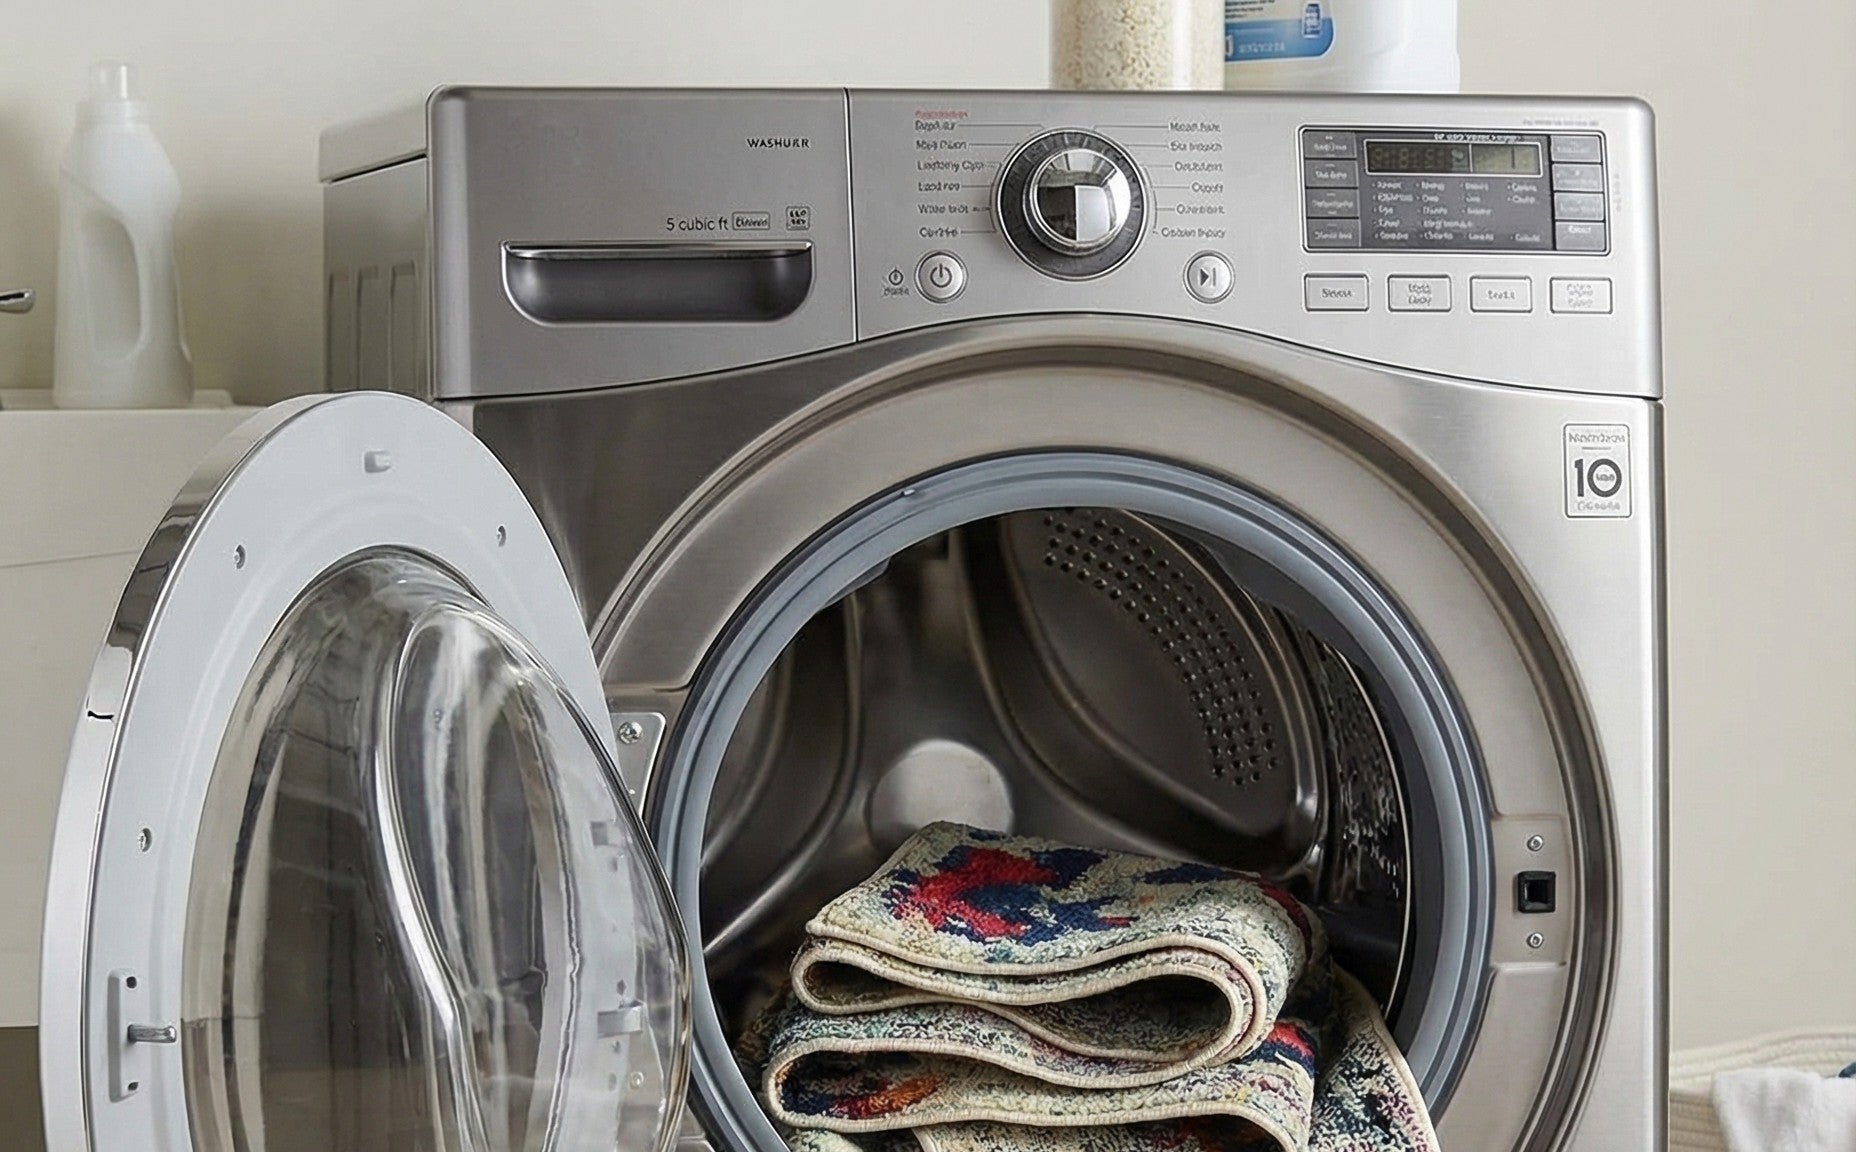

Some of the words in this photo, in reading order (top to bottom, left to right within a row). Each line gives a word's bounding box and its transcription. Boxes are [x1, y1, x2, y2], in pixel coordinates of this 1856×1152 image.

[666, 217, 675, 232] 5
[678, 217, 715, 231] cubic
[718, 216, 729, 231] ft
[1574, 458, 1623, 498] 10
